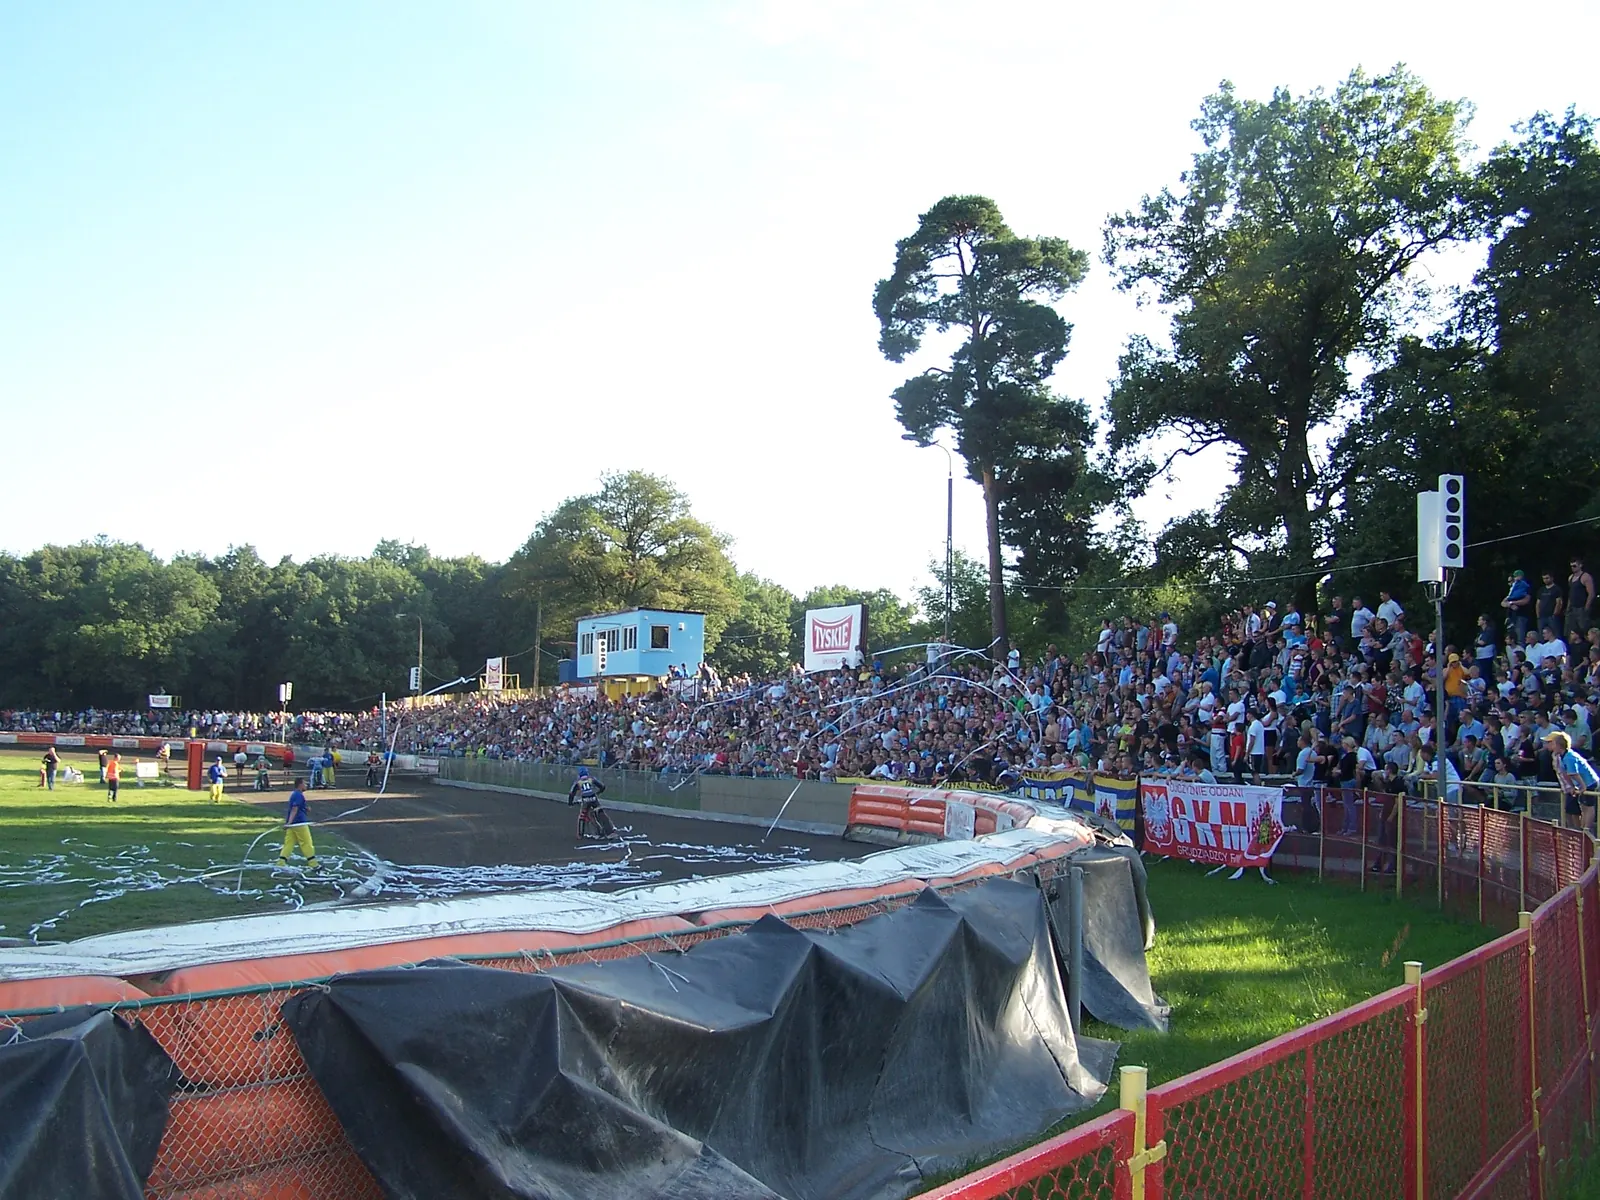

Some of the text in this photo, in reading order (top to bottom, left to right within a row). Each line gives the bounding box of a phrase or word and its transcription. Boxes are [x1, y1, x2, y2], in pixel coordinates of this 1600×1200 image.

[814, 622, 849, 650] TYSKIE
[1208, 786, 1244, 798] ODDANI
[1171, 796, 1248, 851] GKM
